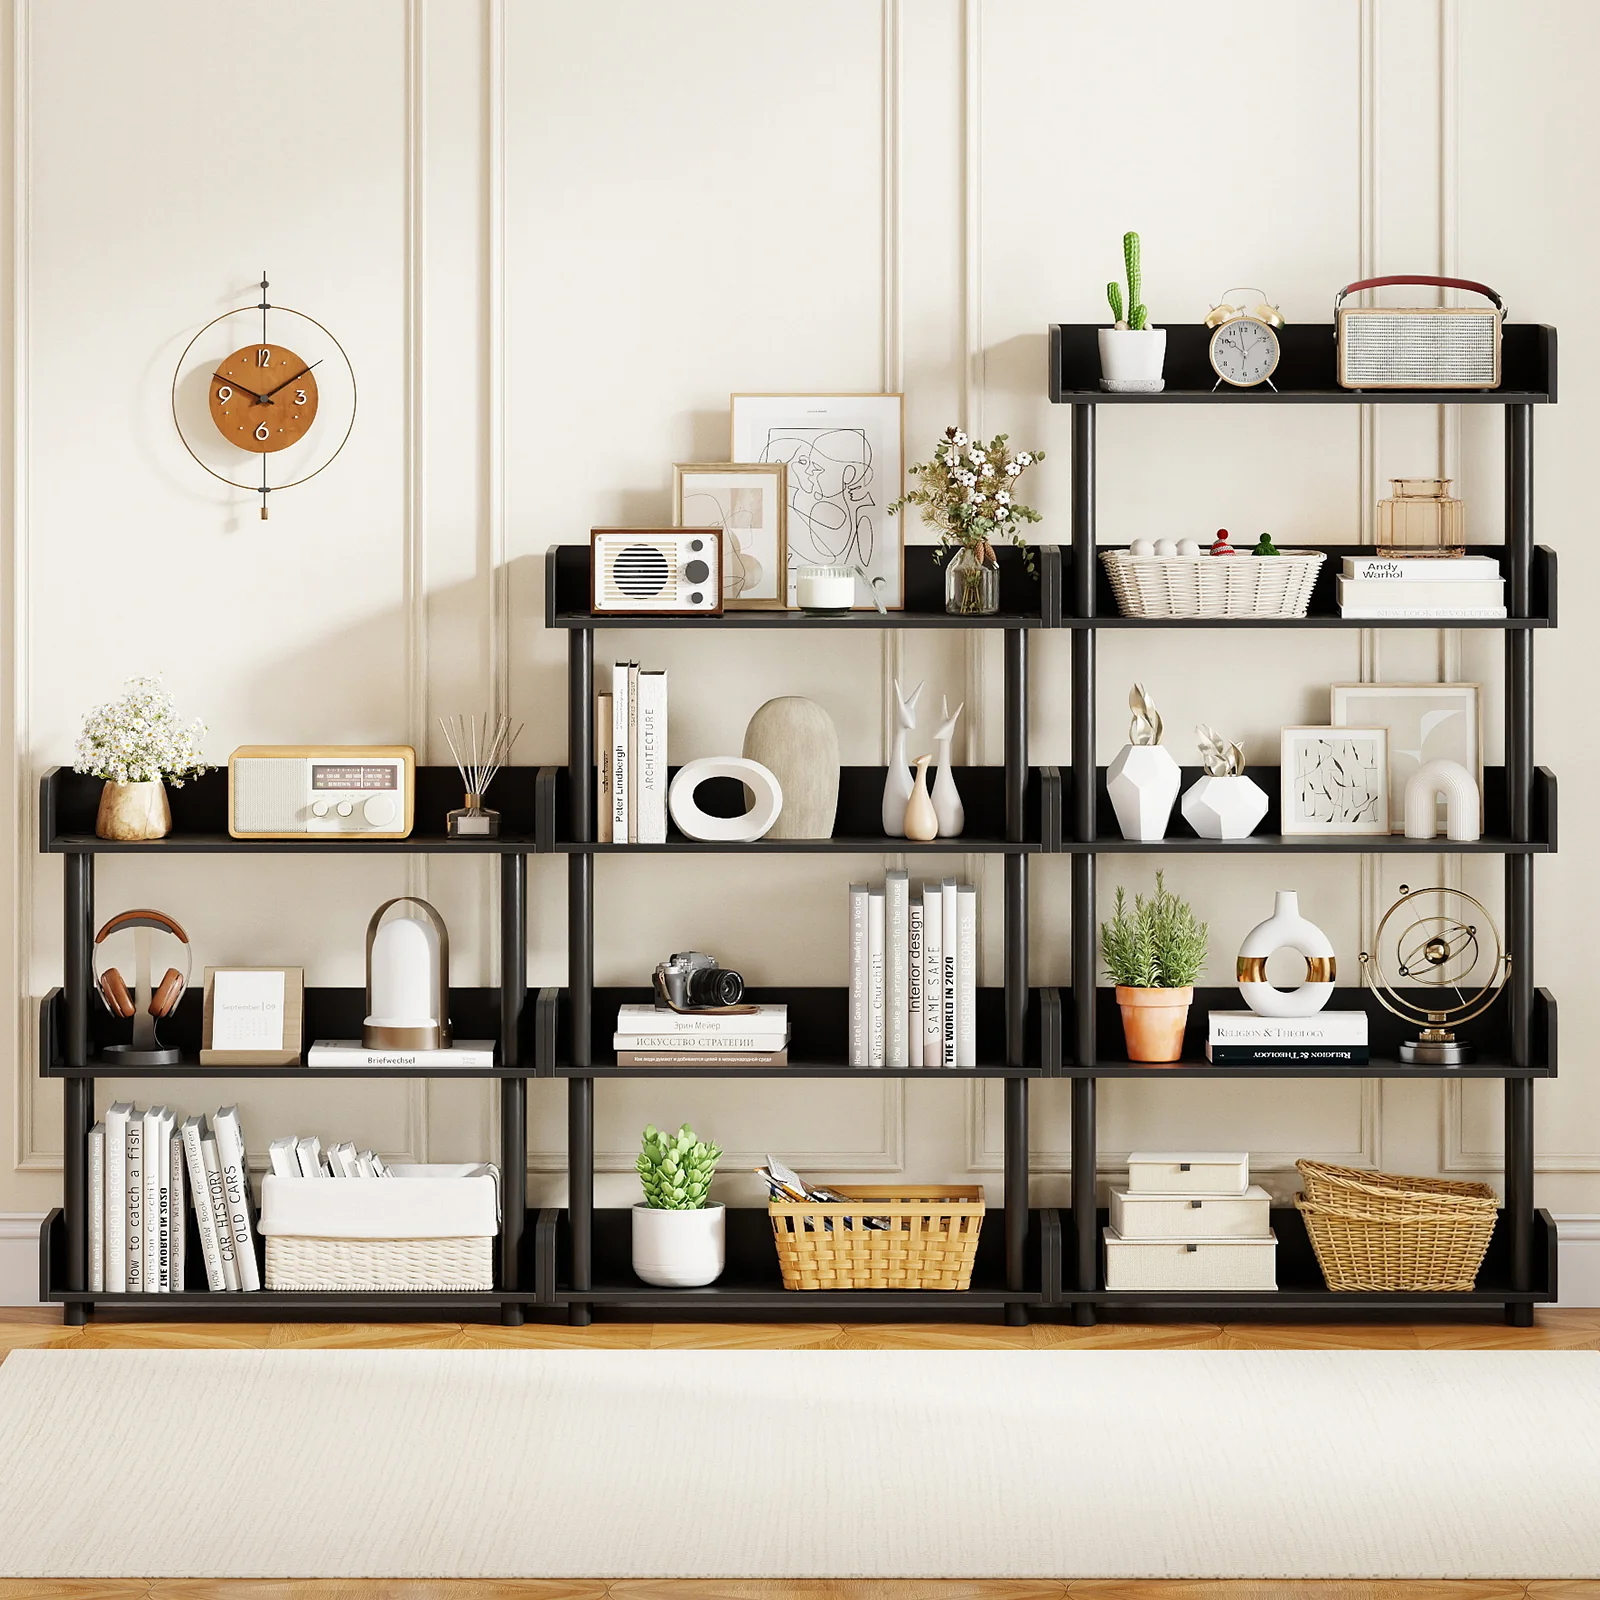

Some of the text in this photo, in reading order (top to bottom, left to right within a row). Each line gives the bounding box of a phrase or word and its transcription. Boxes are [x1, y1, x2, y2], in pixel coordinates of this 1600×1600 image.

[258, 349, 270, 368] 12
[218, 387, 232, 405] 9
[295, 390, 307, 405] 3
[256, 422, 270, 440] 6
[1362, 570, 1402, 578] Warhol
[1368, 562, 1398, 572] Andy
[646, 709, 654, 790] ARCHITECTURE
[616, 745, 626, 822] Peter Lindbergh
[893, 929, 901, 939] in
[854, 932, 863, 962] Hawking
[909, 912, 923, 1012] Interior design
[854, 967, 863, 998] Stephen
[928, 946, 940, 1033] SAME SAME
[961, 917, 971, 1041] HOUSEHOLD DECORATES
[873, 953, 882, 1060] Winston Churchill
[895, 997, 901, 1006] an
[945, 957, 954, 1063] THE WORLD IN 2020
[674, 1021, 720, 1031] Эрин Мейер
[893, 1034, 901, 1042] to
[1263, 1028, 1272, 1037] &
[636, 1038, 696, 1046] ИСКУССТВО
[128, 1129, 140, 1160] fish
[188, 1130, 201, 1174] children
[111, 1138, 121, 1264] HOUSEHOLD DECORATES
[128, 1186, 140, 1226] catch
[224, 1165, 248, 1243] OLD CARS
[173, 1222, 179, 1232] by
[208, 1169, 234, 1262] CAR HISTORY
[130, 1236, 140, 1251] to
[204, 1227, 213, 1248] DRAW
[128, 1260, 140, 1285] How
